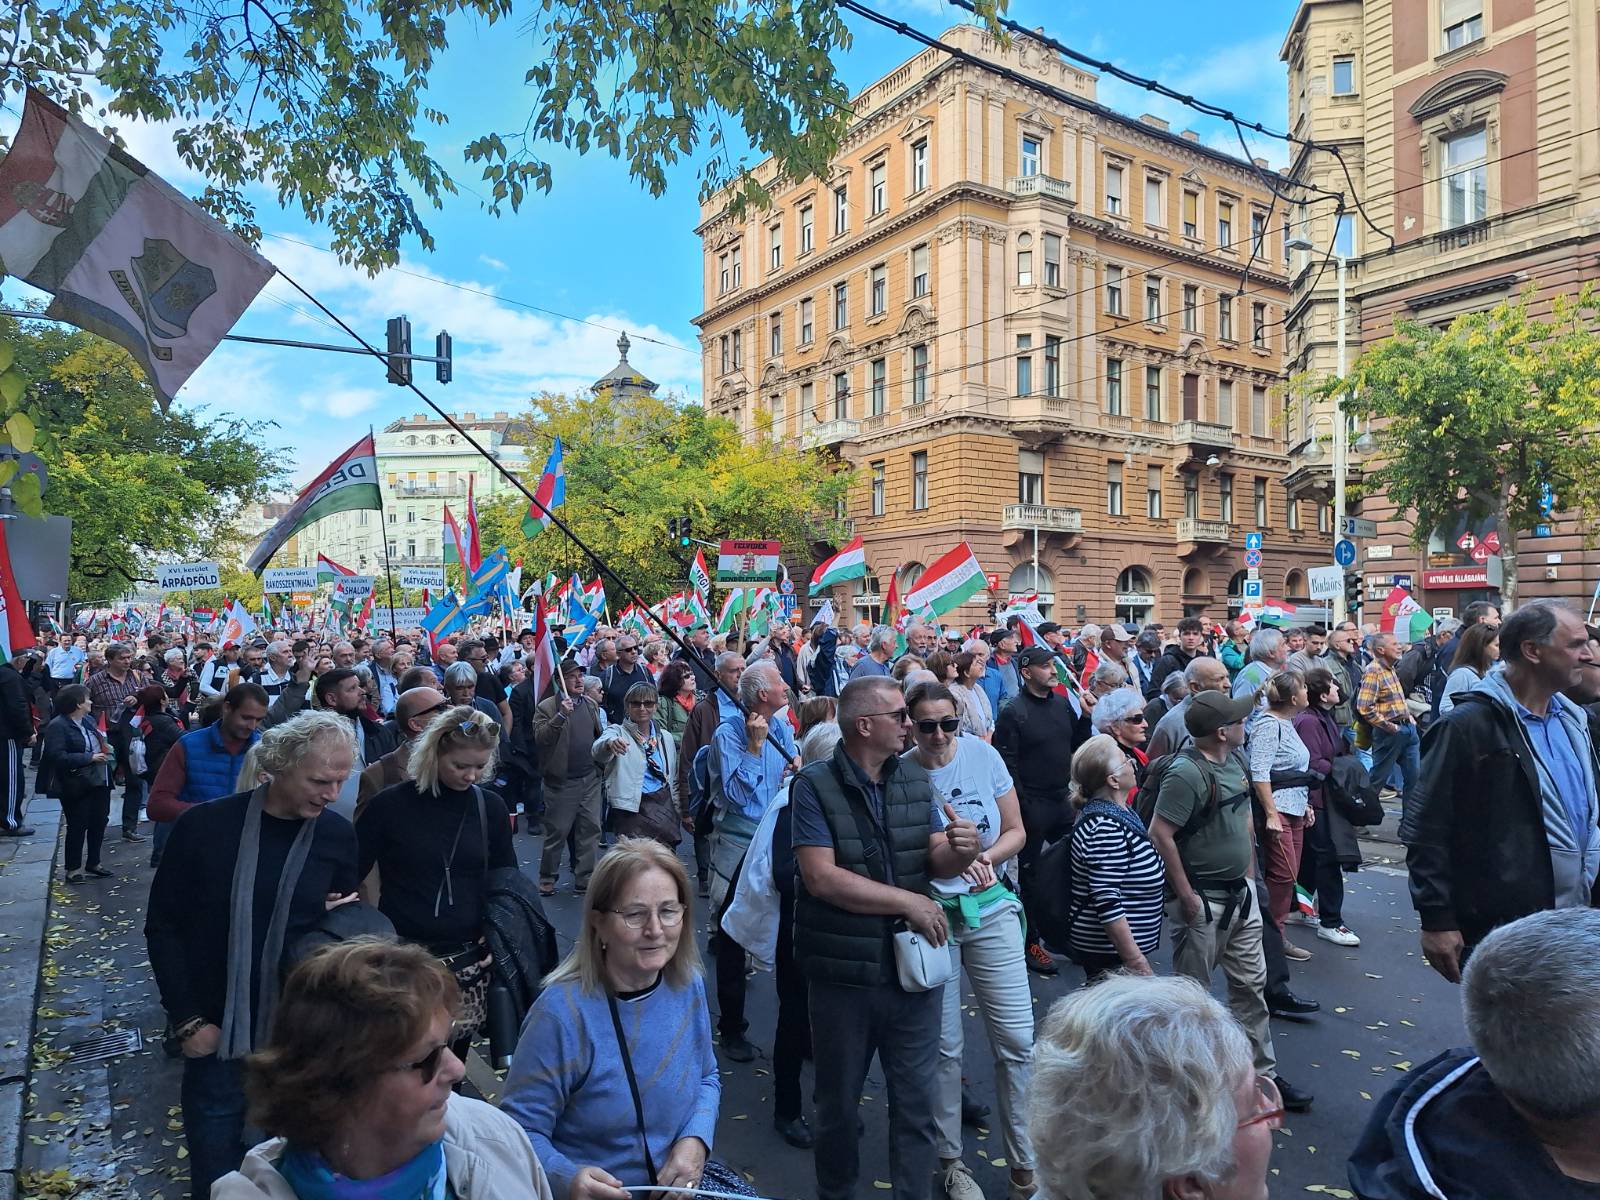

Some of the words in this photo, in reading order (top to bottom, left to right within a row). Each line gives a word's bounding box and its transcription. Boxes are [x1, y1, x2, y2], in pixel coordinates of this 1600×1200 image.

[161, 573, 218, 589] ÁRPÁDFÖLD
[403, 575, 443, 587] MÁTYÁSFÖLD
[1311, 575, 1343, 594] Budaörs
[1248, 583, 1257, 595] P
